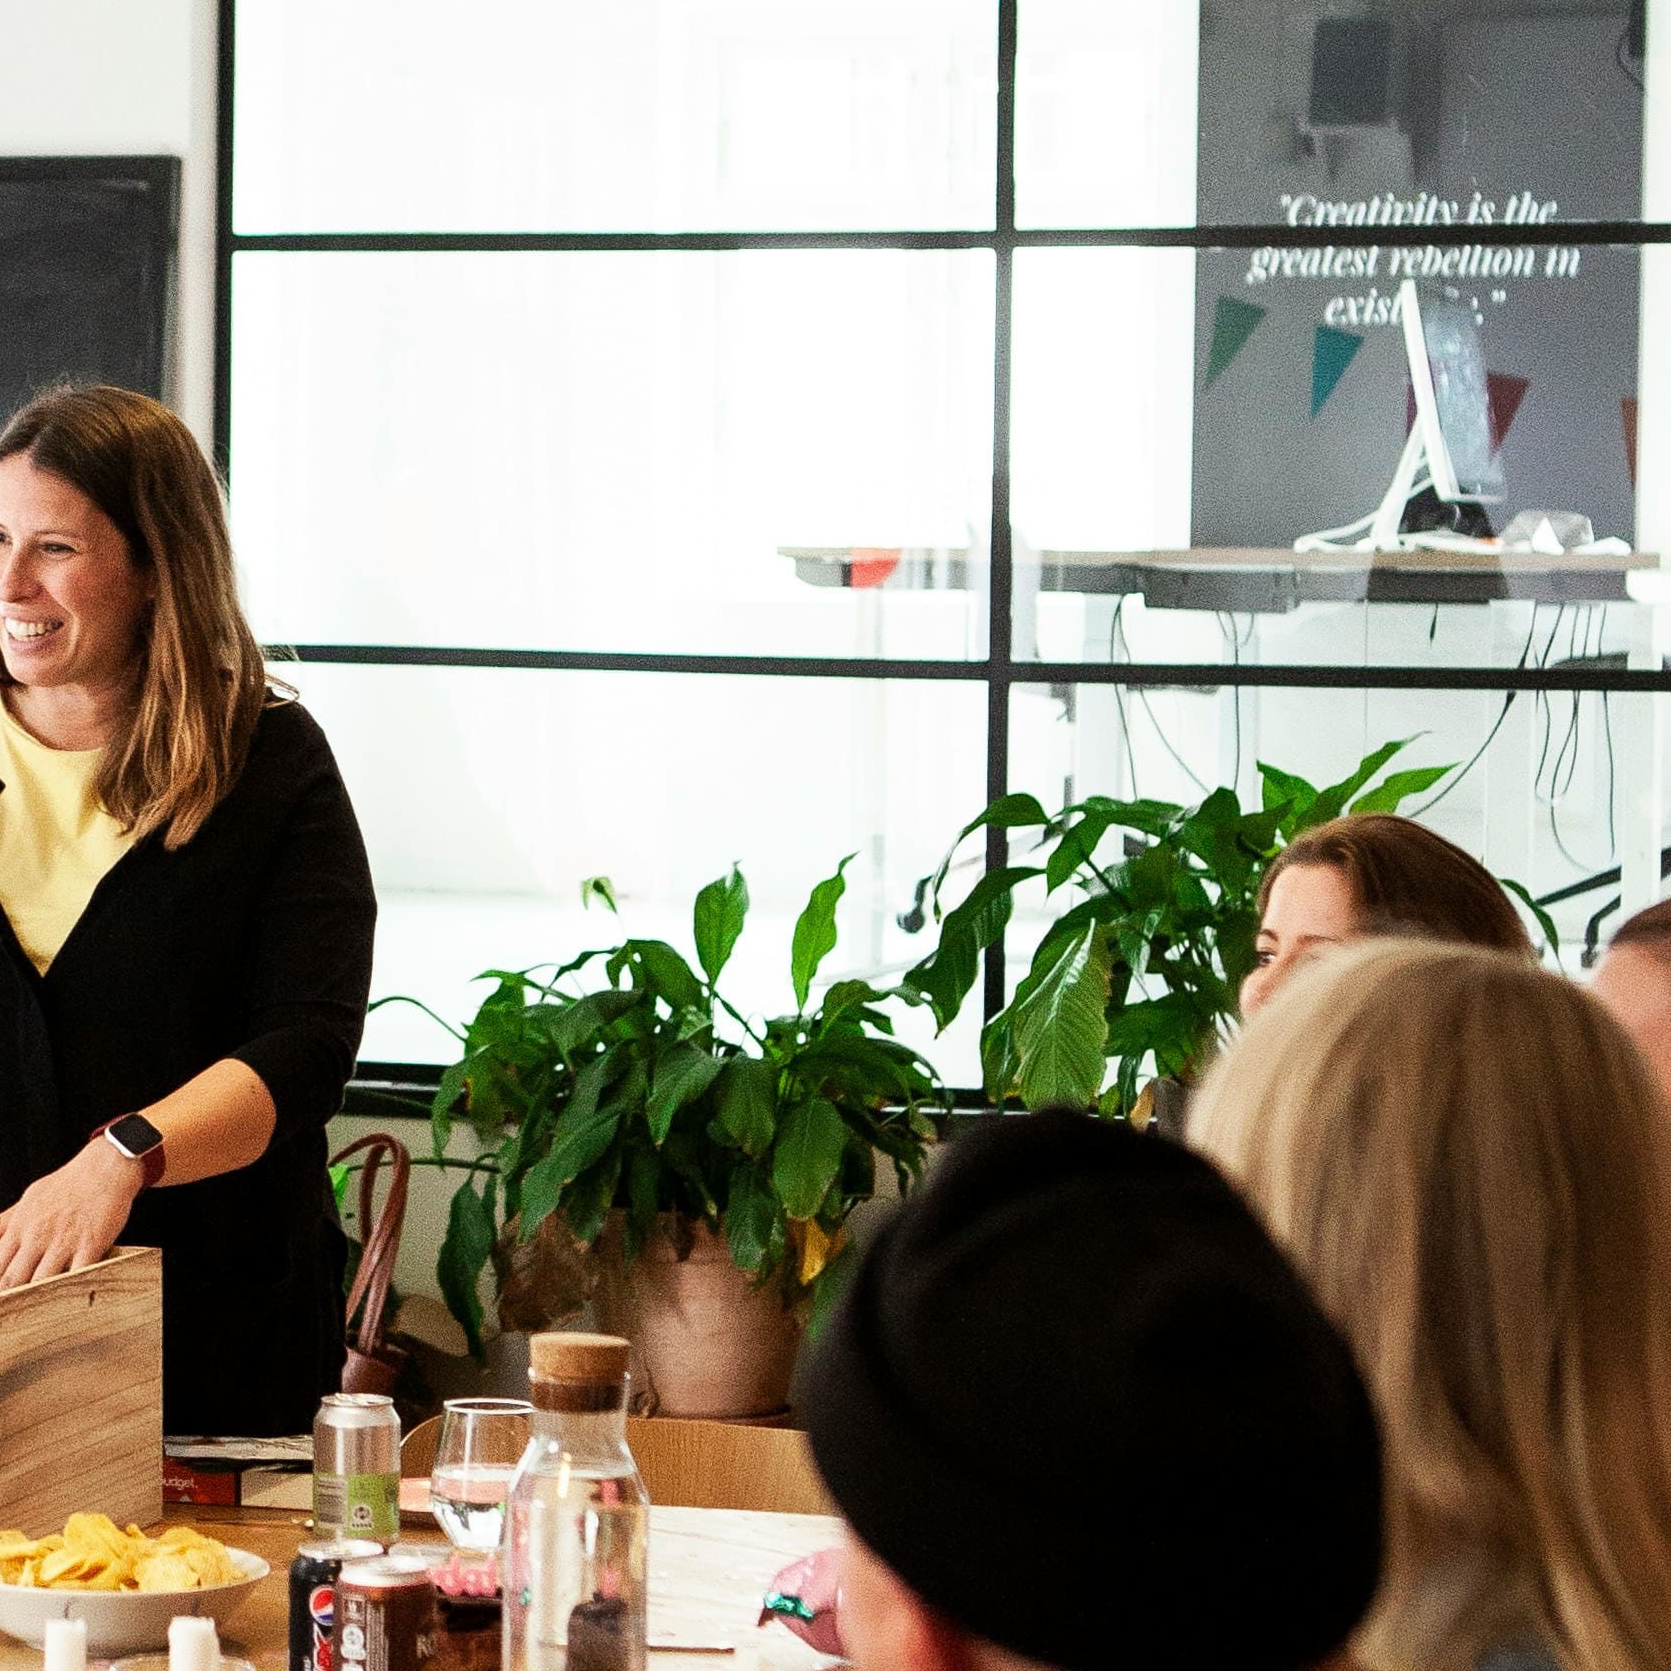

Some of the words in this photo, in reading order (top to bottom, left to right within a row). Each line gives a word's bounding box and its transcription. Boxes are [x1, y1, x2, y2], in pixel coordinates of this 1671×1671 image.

[1467, 191, 1496, 226] is
[1504, 191, 1558, 226] the
[1245, 245, 1379, 284] greatest
[1390, 245, 1536, 277] rebellion
[1545, 246, 1581, 277] in
[162, 1475, 198, 1491] udget.
